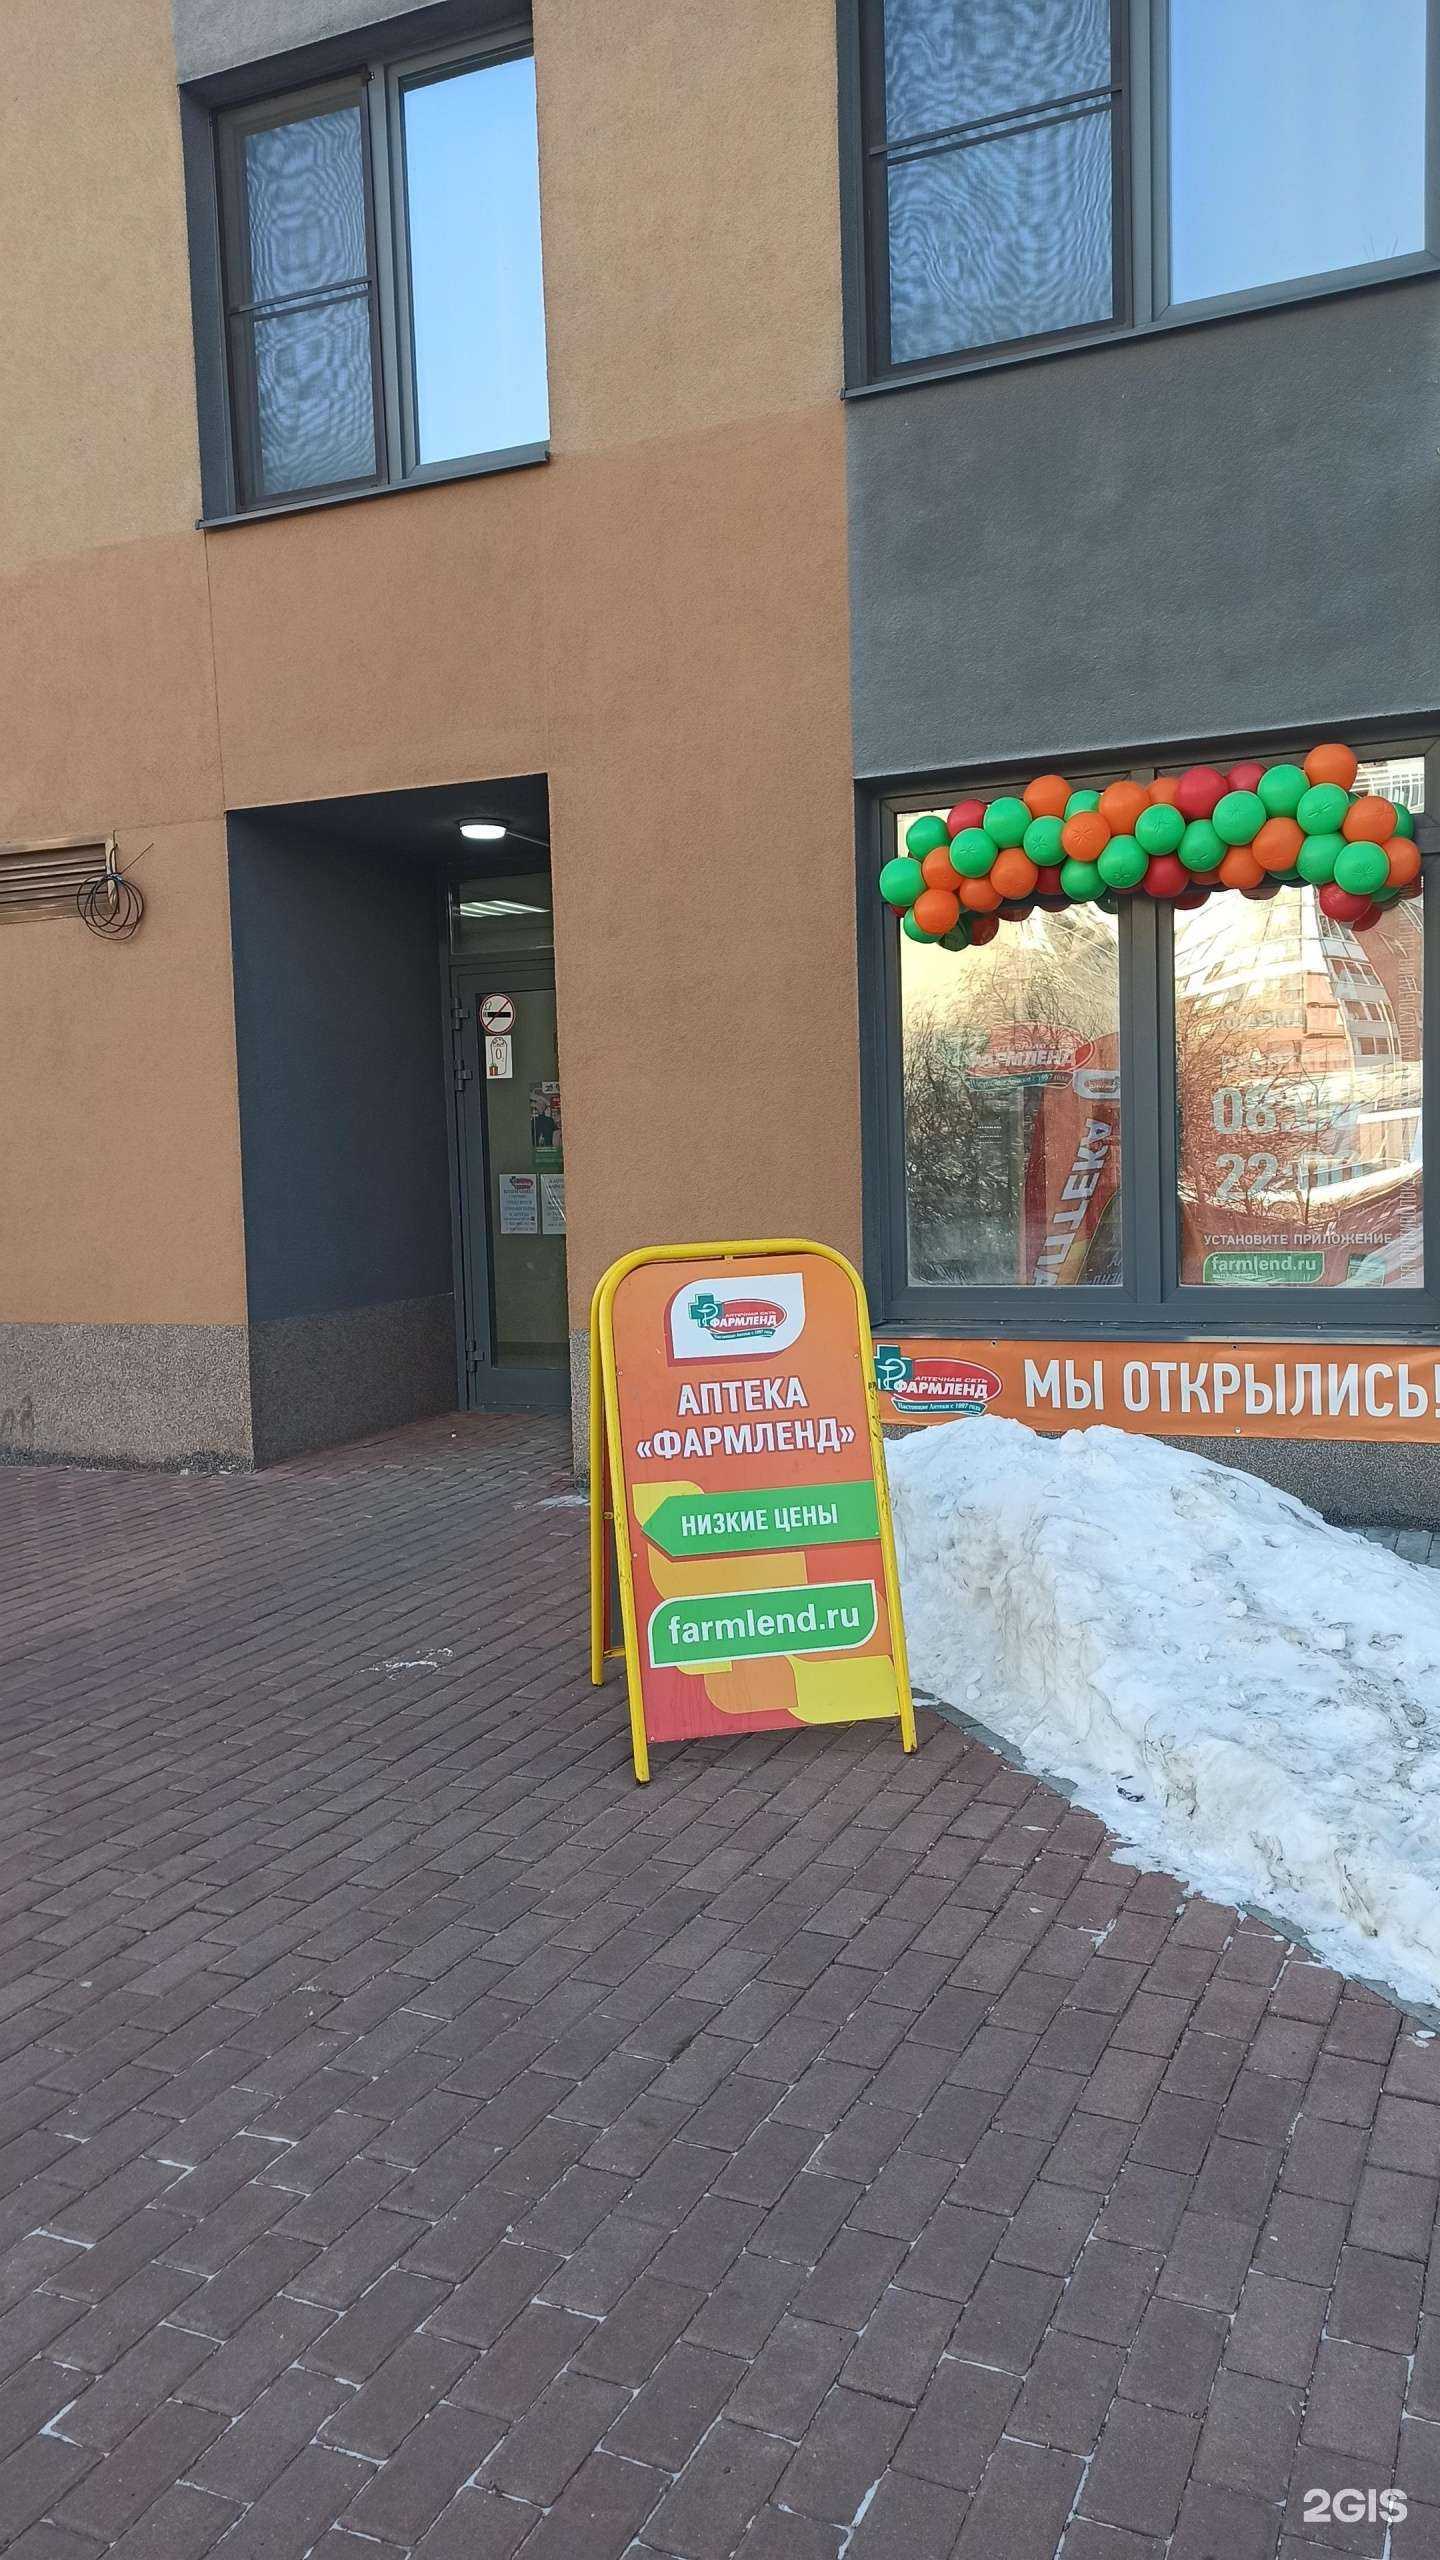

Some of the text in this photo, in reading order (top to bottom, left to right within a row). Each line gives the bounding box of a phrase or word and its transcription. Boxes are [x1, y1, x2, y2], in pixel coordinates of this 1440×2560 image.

[1203, 1232, 1393, 1246] УСТАНОВИТЕ ПРИЛОЖЕНИЕ
[1211, 1255, 1316, 1272] farmlend.ru
[710, 1315, 777, 1328] ФАРМЛЕНД
[677, 1376, 808, 1417] АПТЕКА
[893, 1379, 988, 1399] ФАРМЛЕНД
[1023, 1358, 1440, 1417] МЫ ОТКРЫЛИСЬ!
[635, 1416, 855, 1459] «ФАРМЛЕНД»
[680, 1503, 839, 1537] НИЗКИЕ ЦЕНЫ
[667, 1603, 860, 1645] farmlend.ru
